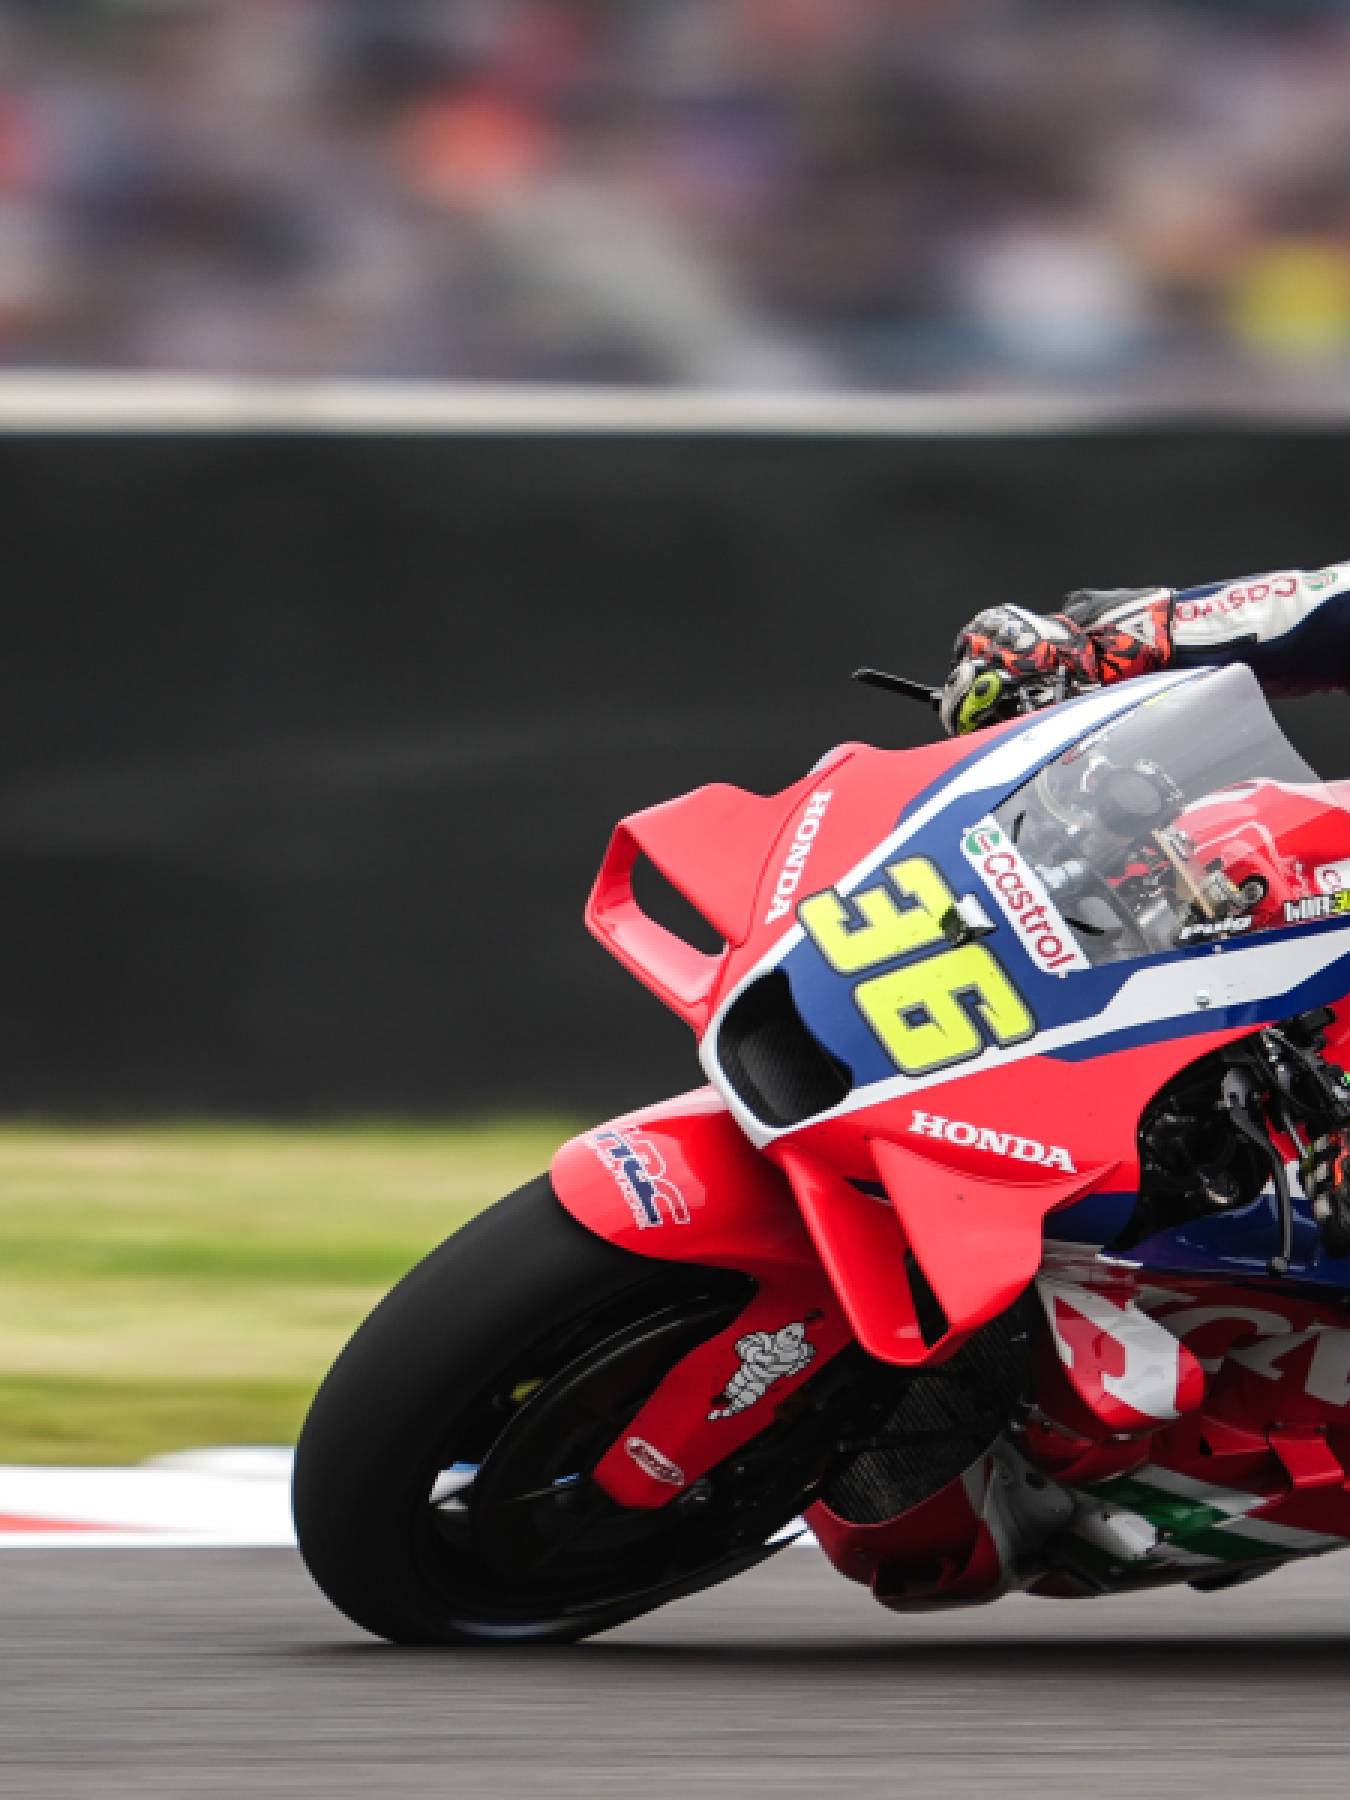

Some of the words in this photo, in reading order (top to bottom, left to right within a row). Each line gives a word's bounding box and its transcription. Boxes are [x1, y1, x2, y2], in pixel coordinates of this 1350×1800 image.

[764, 791, 833, 925] HONDA
[983, 850, 1077, 972] Castrol
[796, 855, 1038, 1077] 36
[907, 1109, 1078, 1174] HONDA
